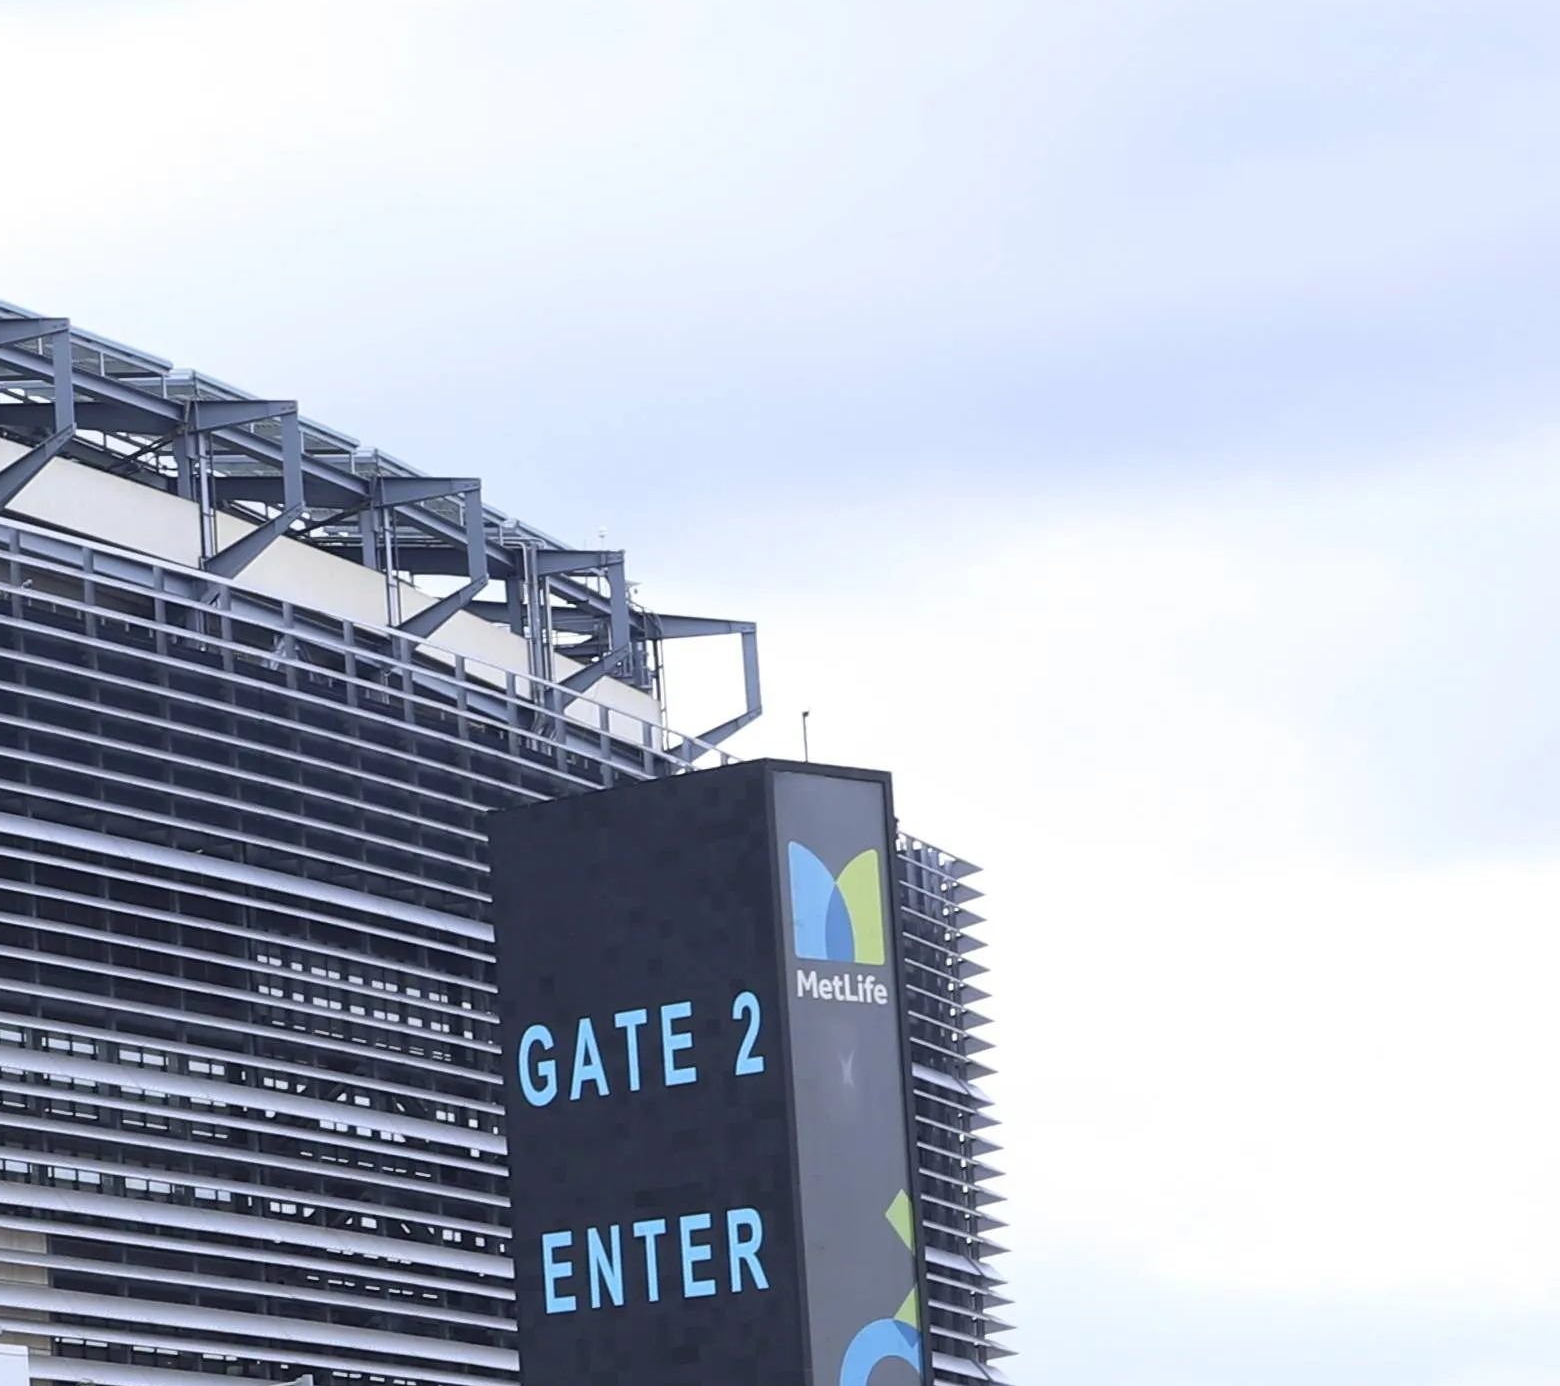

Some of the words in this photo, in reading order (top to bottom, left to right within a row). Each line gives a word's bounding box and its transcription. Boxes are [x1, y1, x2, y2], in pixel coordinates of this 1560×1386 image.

[796, 969, 889, 1005] MetLife
[519, 1001, 697, 1107] GATE
[732, 991, 766, 1076] 2
[541, 1207, 770, 1315] ENTER
